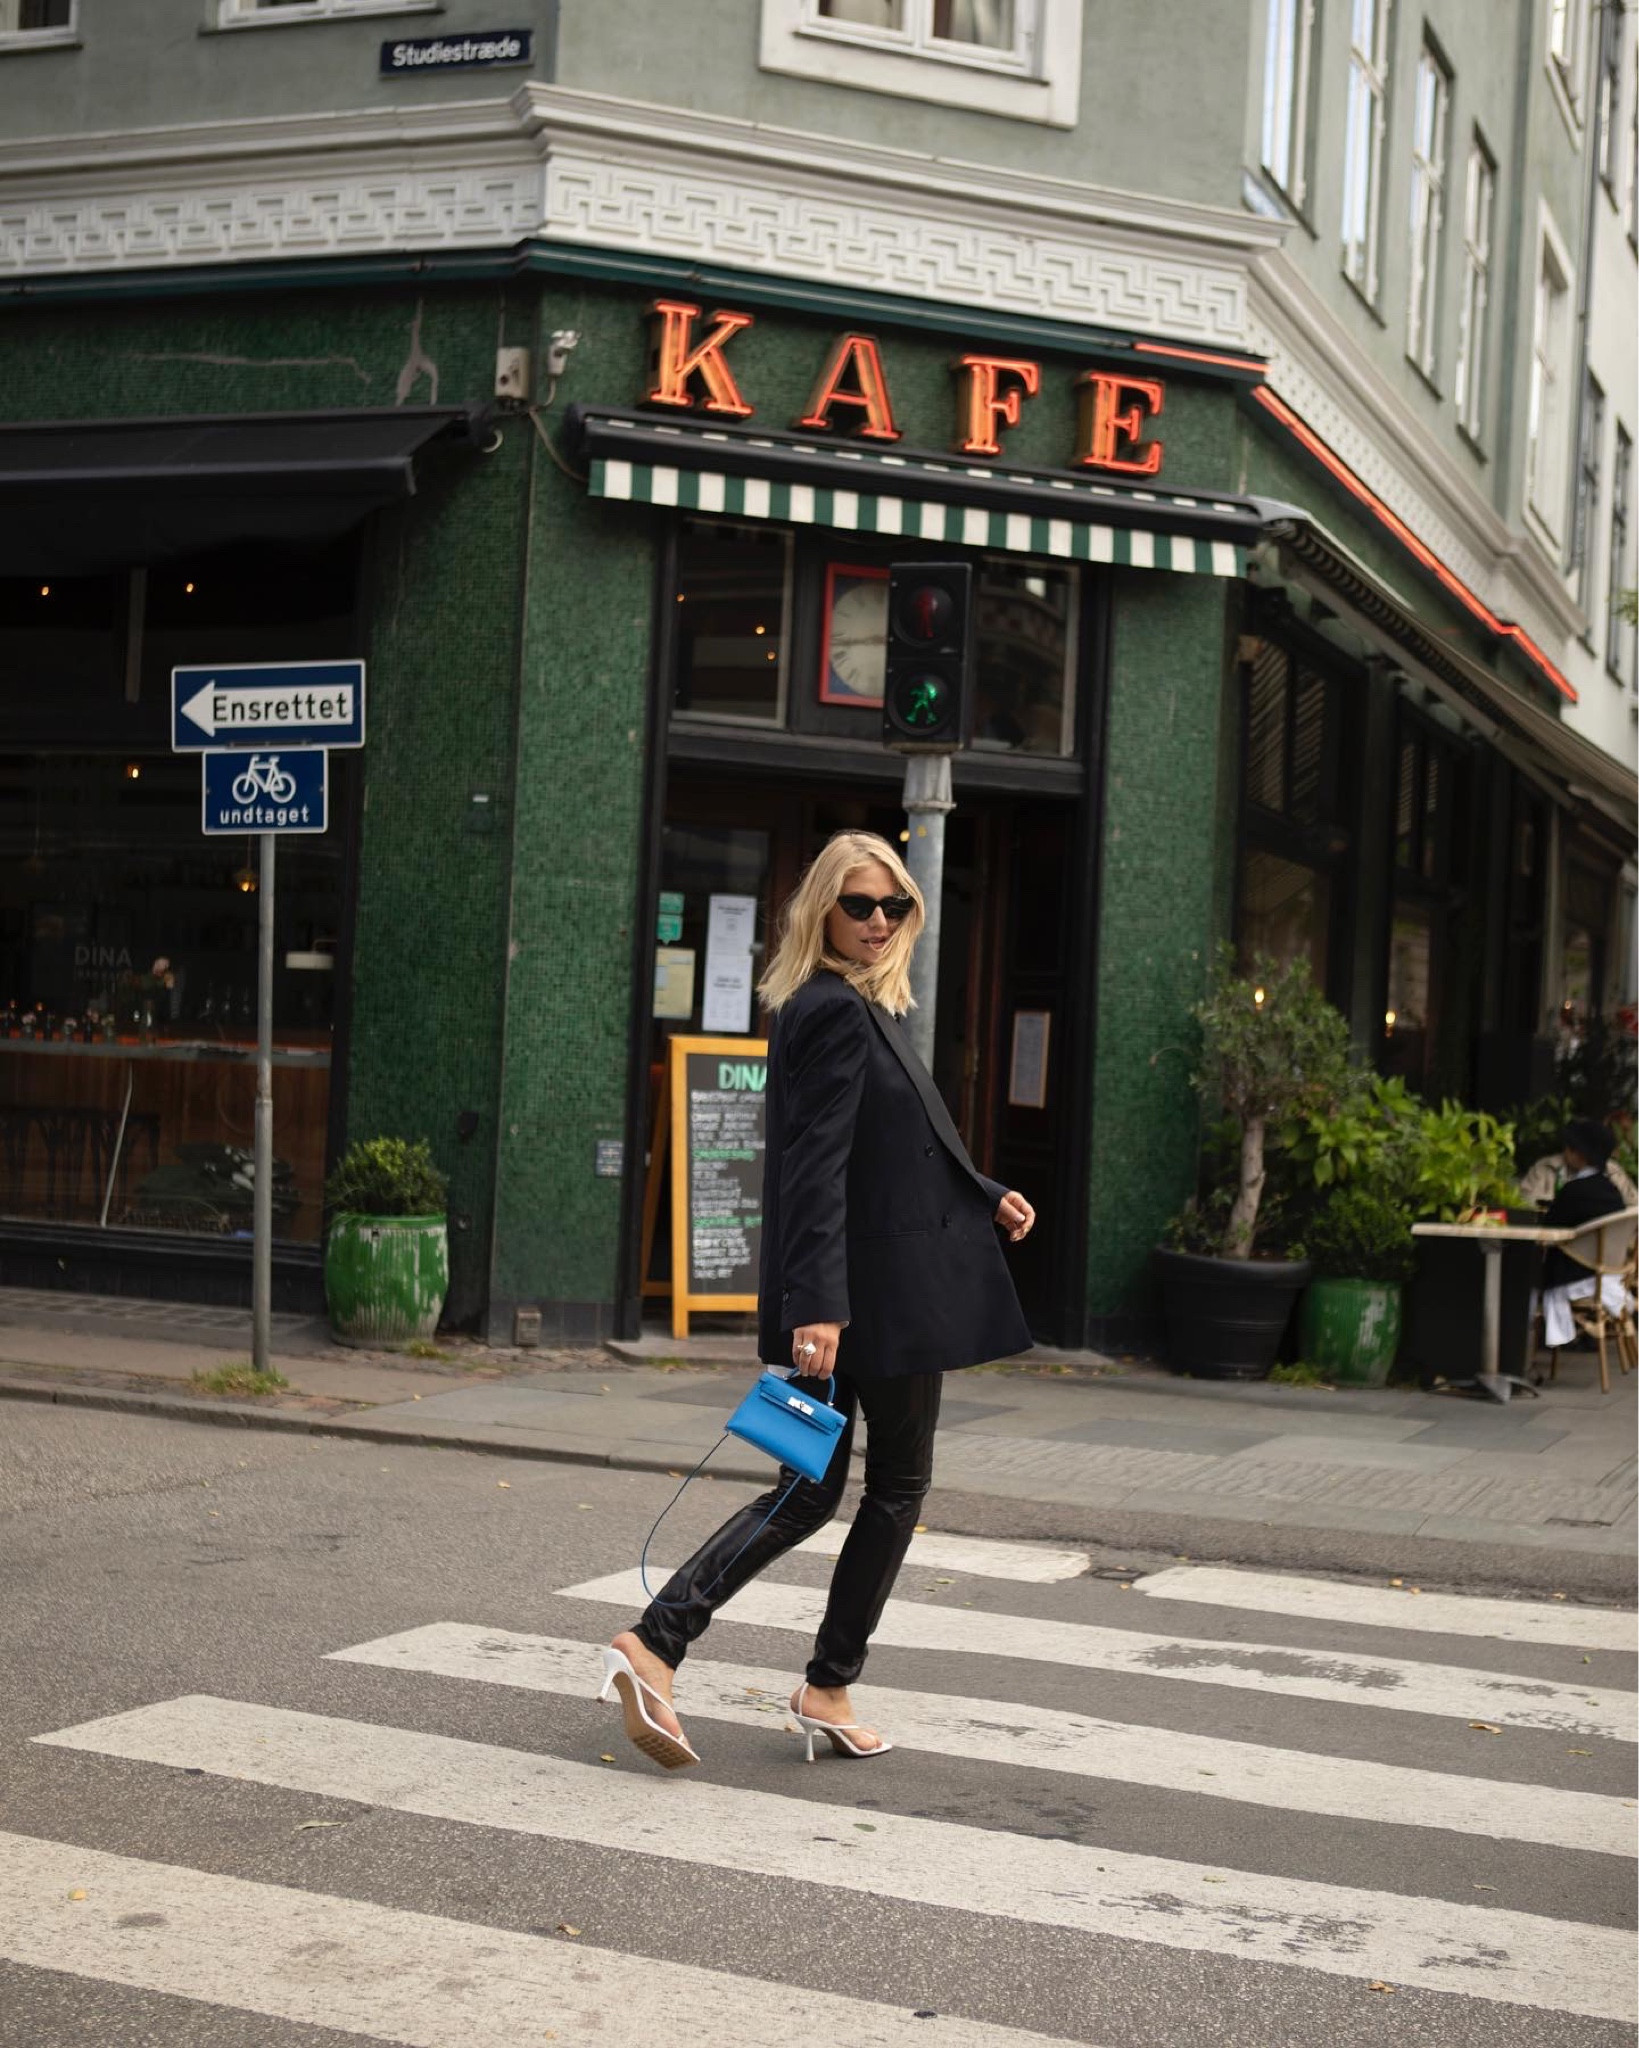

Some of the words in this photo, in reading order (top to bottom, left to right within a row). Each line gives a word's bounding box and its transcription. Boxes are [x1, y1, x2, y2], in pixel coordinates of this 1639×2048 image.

[392, 35, 521, 67] Studiestræde
[646, 299, 1165, 475] KAFE
[213, 691, 348, 722] Ensrettet
[219, 804, 310, 826] undtaget
